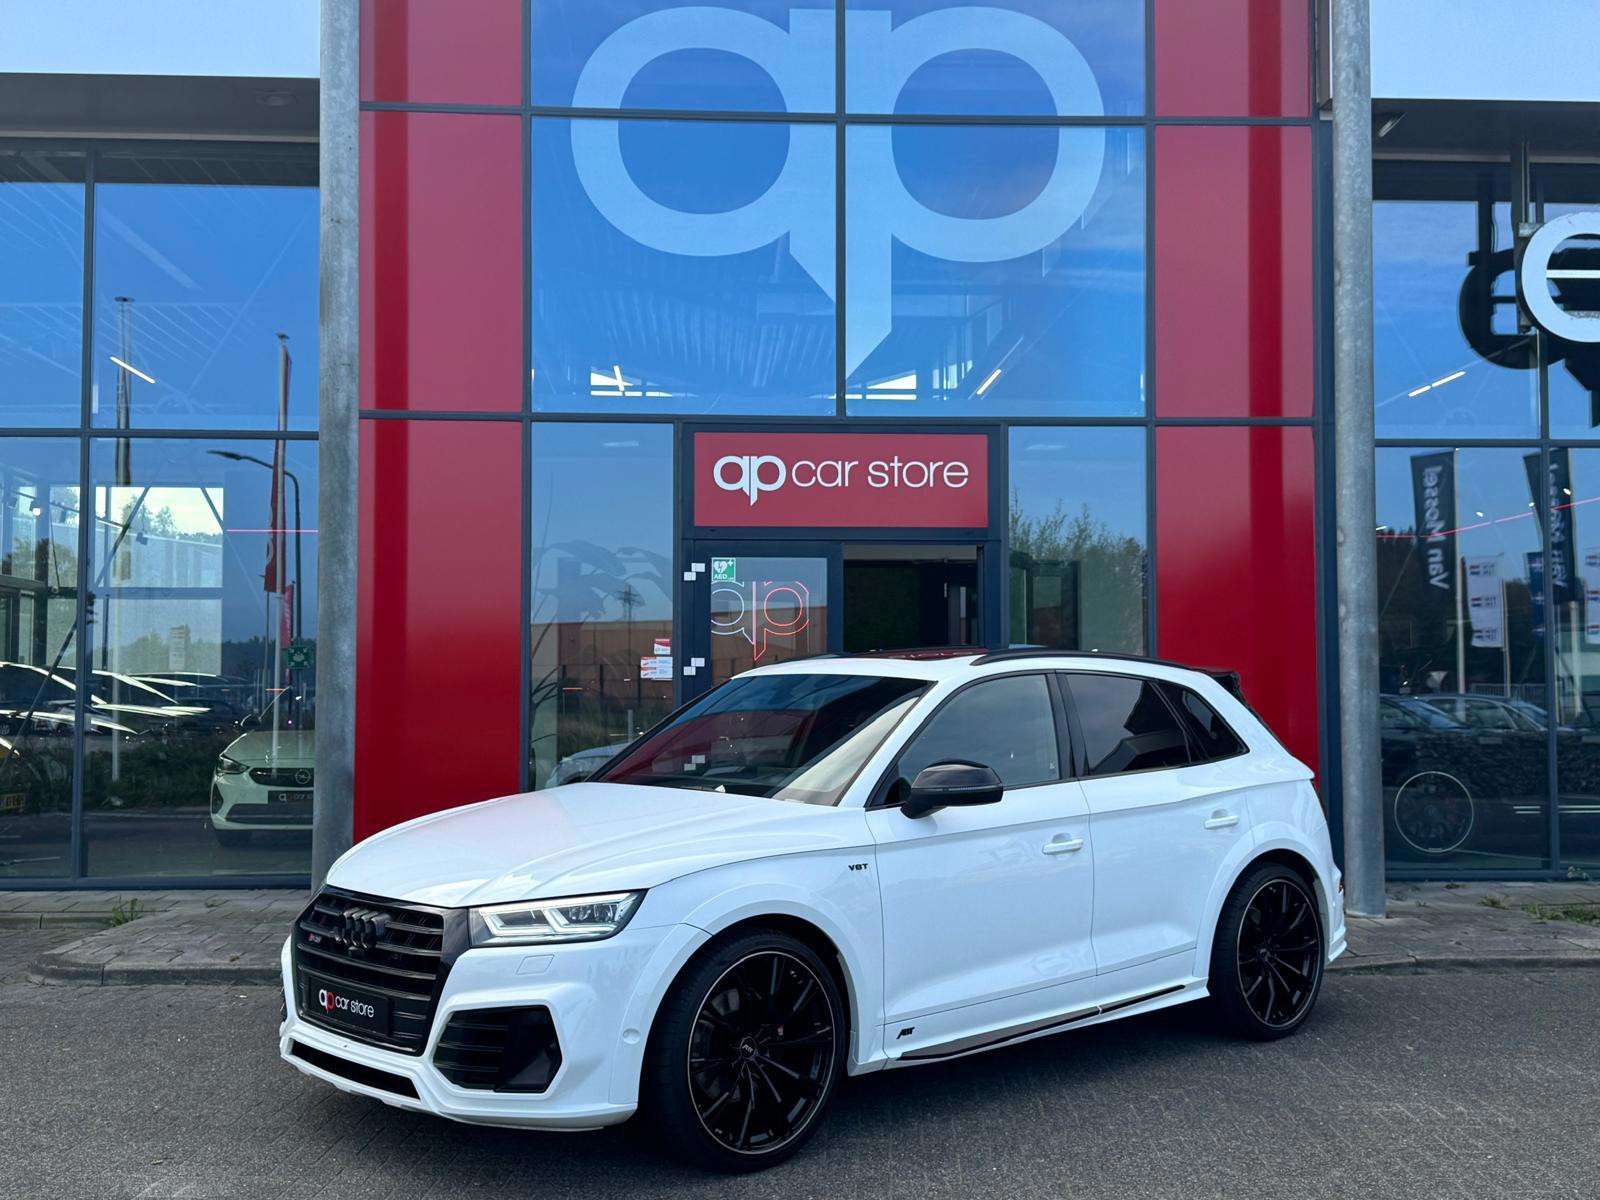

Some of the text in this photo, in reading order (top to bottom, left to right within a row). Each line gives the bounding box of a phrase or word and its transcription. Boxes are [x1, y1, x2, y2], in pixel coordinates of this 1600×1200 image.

[713, 454, 969, 507] ap car store
[335, 996, 350, 1010] car
[350, 1000, 375, 1018] store
